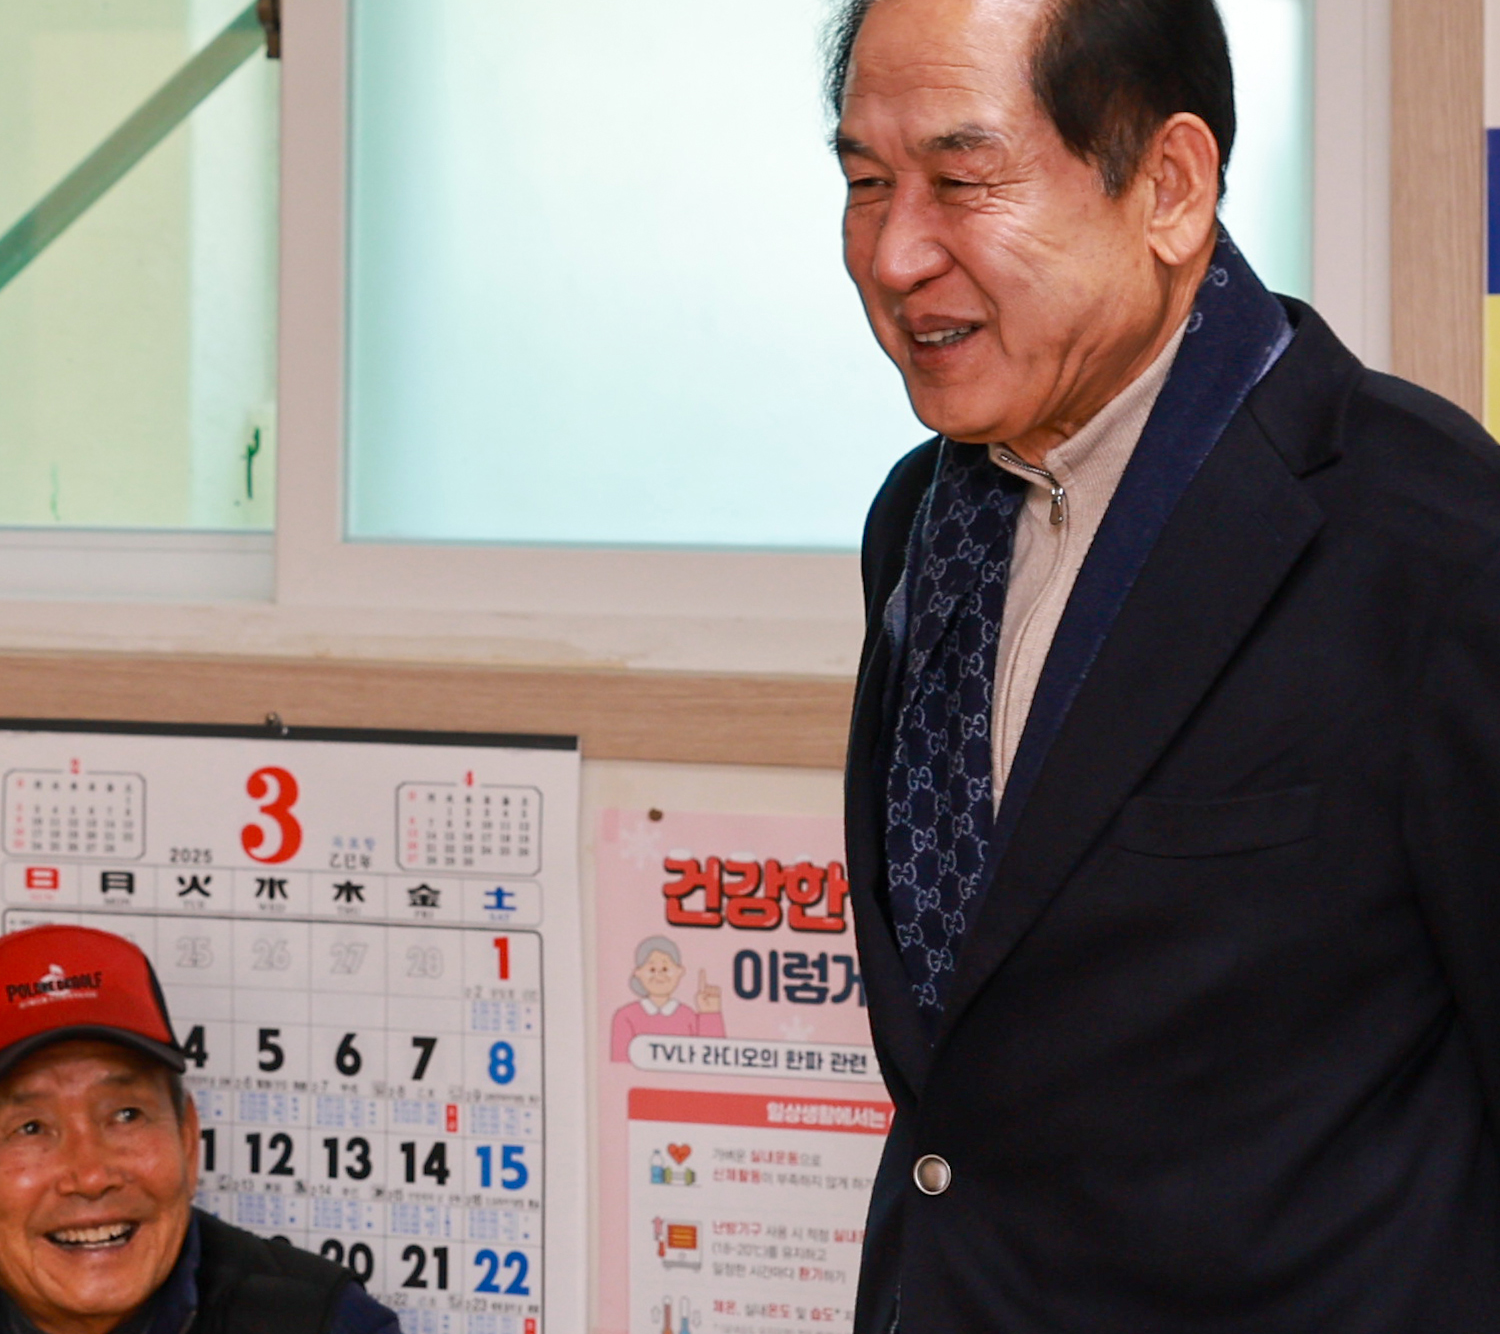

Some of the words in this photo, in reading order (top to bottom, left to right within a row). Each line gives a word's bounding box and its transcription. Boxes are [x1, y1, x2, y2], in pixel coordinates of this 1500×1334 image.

[464, 770, 474, 787] 4
[241, 766, 303, 865] 3
[170, 848, 212, 863] 2025
[26, 867, 59, 889] 日
[100, 871, 135, 895] 月
[177, 875, 213, 897] 火
[255, 877, 289, 900] 水
[333, 881, 366, 904] 木
[407, 883, 441, 908] 金
[483, 887, 517, 911] 土
[662, 856, 849, 933] 건강한
[176, 936, 215, 968] 25
[251, 940, 291, 972] 26
[329, 943, 368, 975] 27
[406, 946, 444, 978] 28
[493, 936, 510, 980] 1
[183, 1025, 209, 1068] 4
[258, 1027, 285, 1073] 5
[335, 1033, 362, 1077] 6
[411, 1036, 438, 1081] 7
[488, 1041, 516, 1084] 8
[649, 1043, 696, 1062] TV나
[703, 1045, 778, 1068] 라디오의
[786, 1051, 823, 1071] 한파
[831, 1054, 867, 1075] 관련
[246, 1132, 294, 1176] 12
[323, 1136, 372, 1181] 13
[400, 1141, 450, 1186] 14
[475, 1145, 529, 1191] 15
[402, 1244, 449, 1291] 21
[474, 1249, 530, 1296] 22
